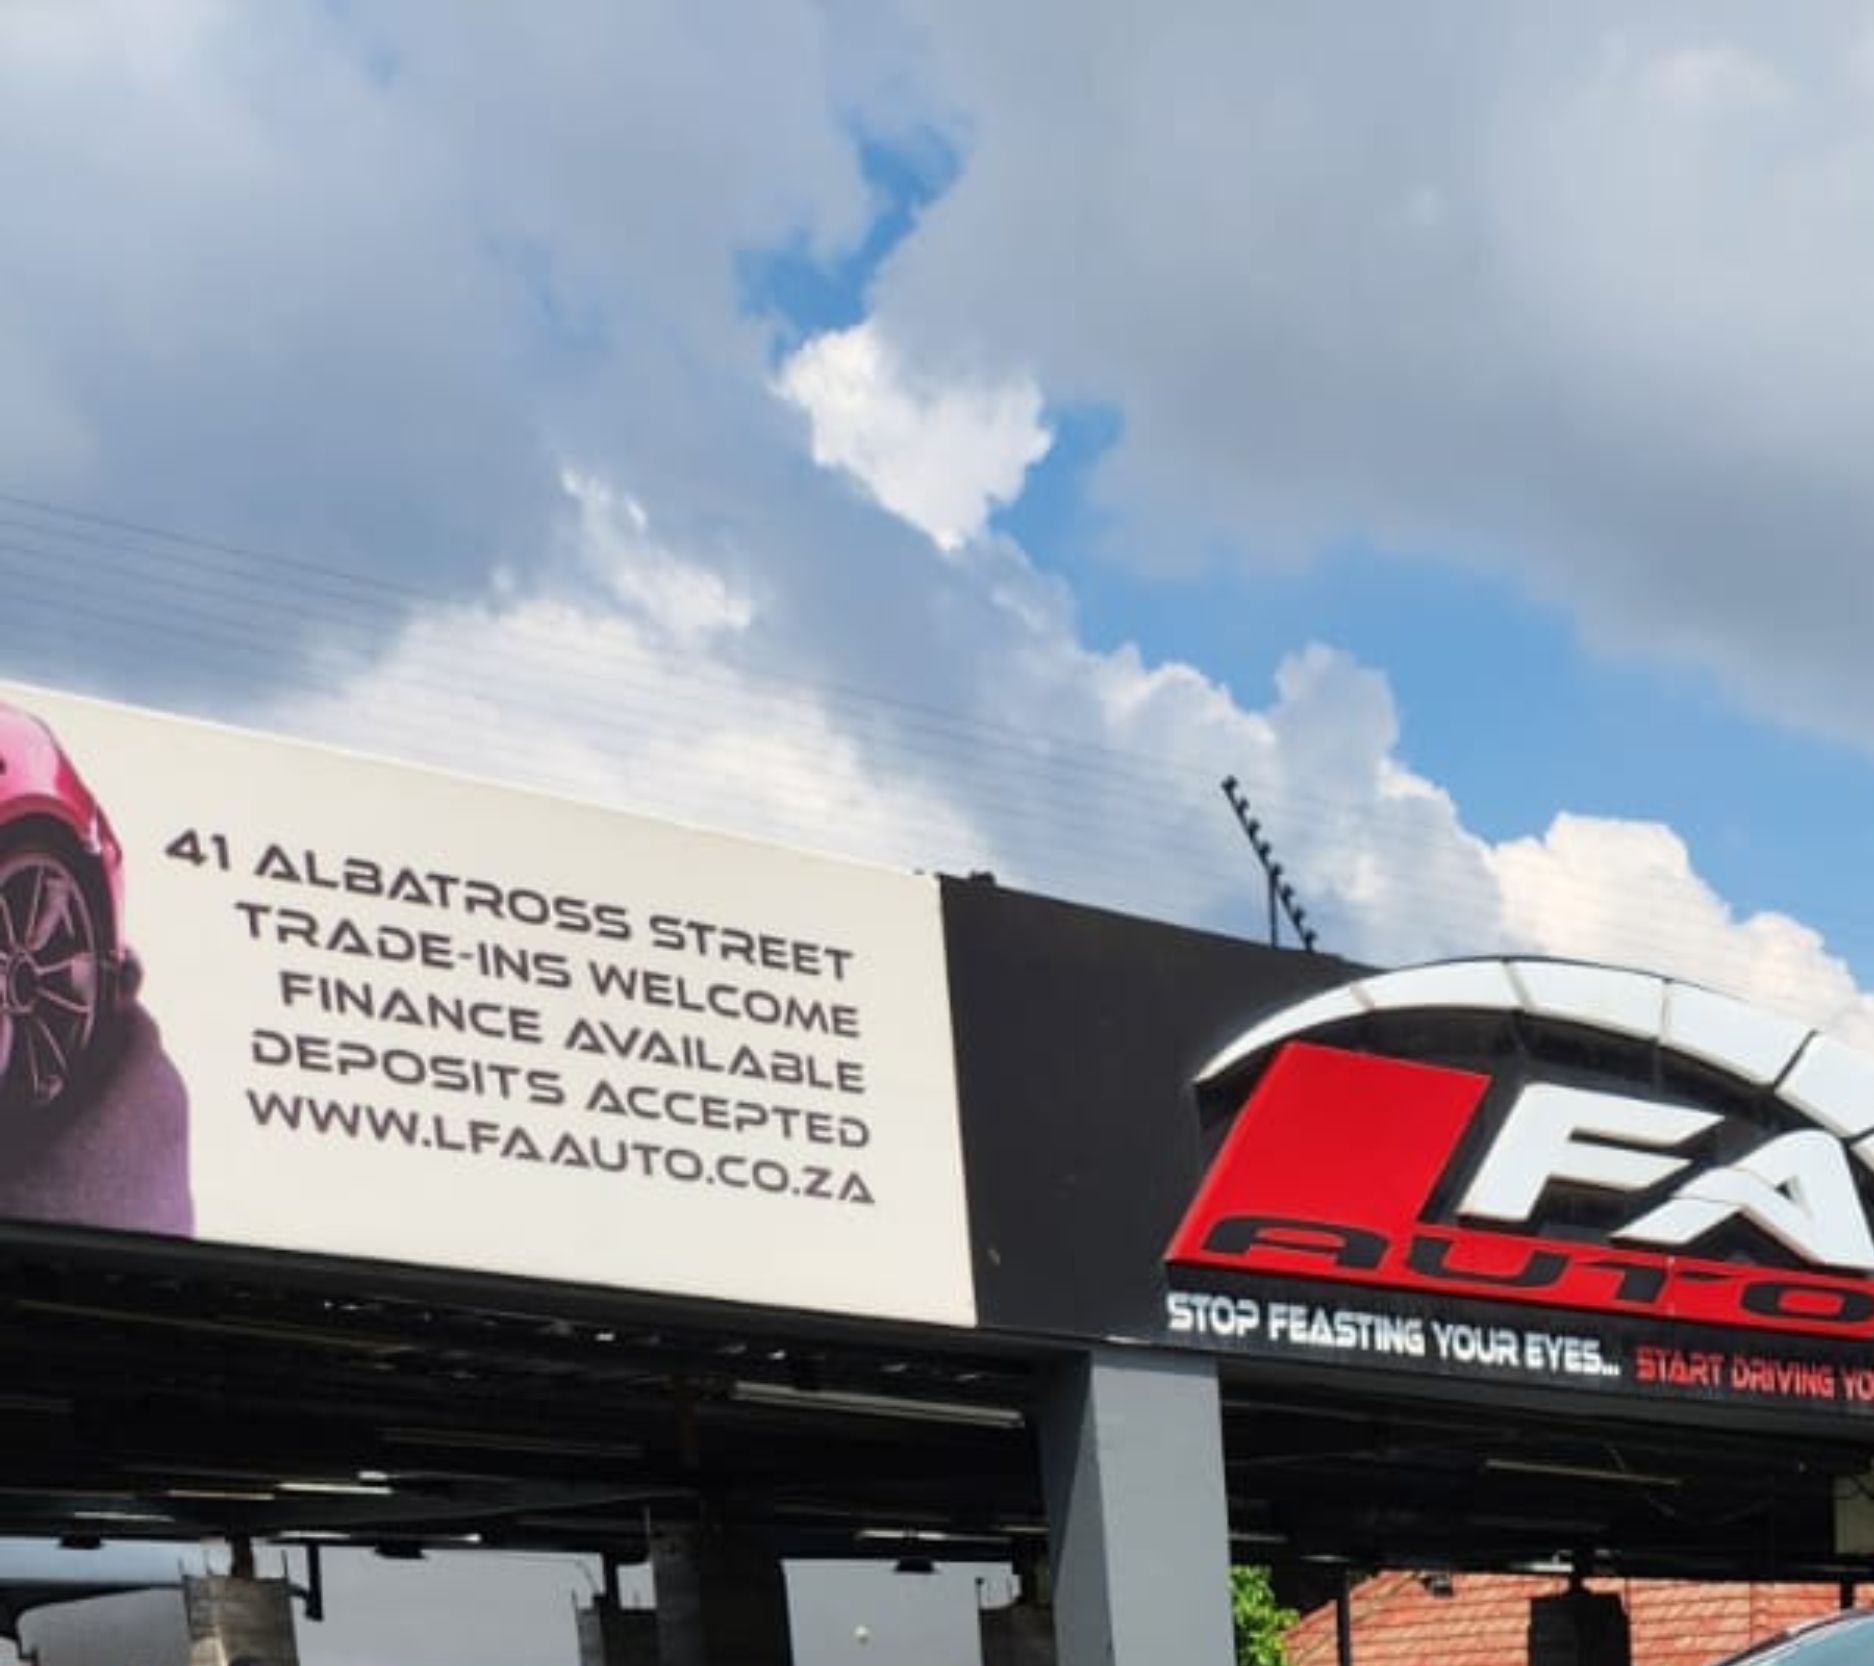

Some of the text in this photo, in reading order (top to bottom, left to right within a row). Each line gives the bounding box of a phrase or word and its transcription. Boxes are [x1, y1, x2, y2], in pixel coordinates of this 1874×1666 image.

[165, 829, 853, 980] 41 ALBATROSS STREET
[235, 902, 858, 1038] TRADE-INS WELCOME
[252, 1029, 869, 1148] DEPOSITS ACCEPTED
[280, 971, 864, 1094] FINANCE AVAILABLE
[247, 1090, 875, 1204] WWW.LFAAUTO.CO.ZA
[1166, 1292, 1260, 1338] STOP
[1267, 1302, 1427, 1358] FEASTING
[1431, 1321, 1520, 1367] YOUR
[1524, 1333, 1621, 1378] EYES...
[1634, 1345, 1725, 1386] START
[1731, 1352, 1836, 1398] DRIVING
